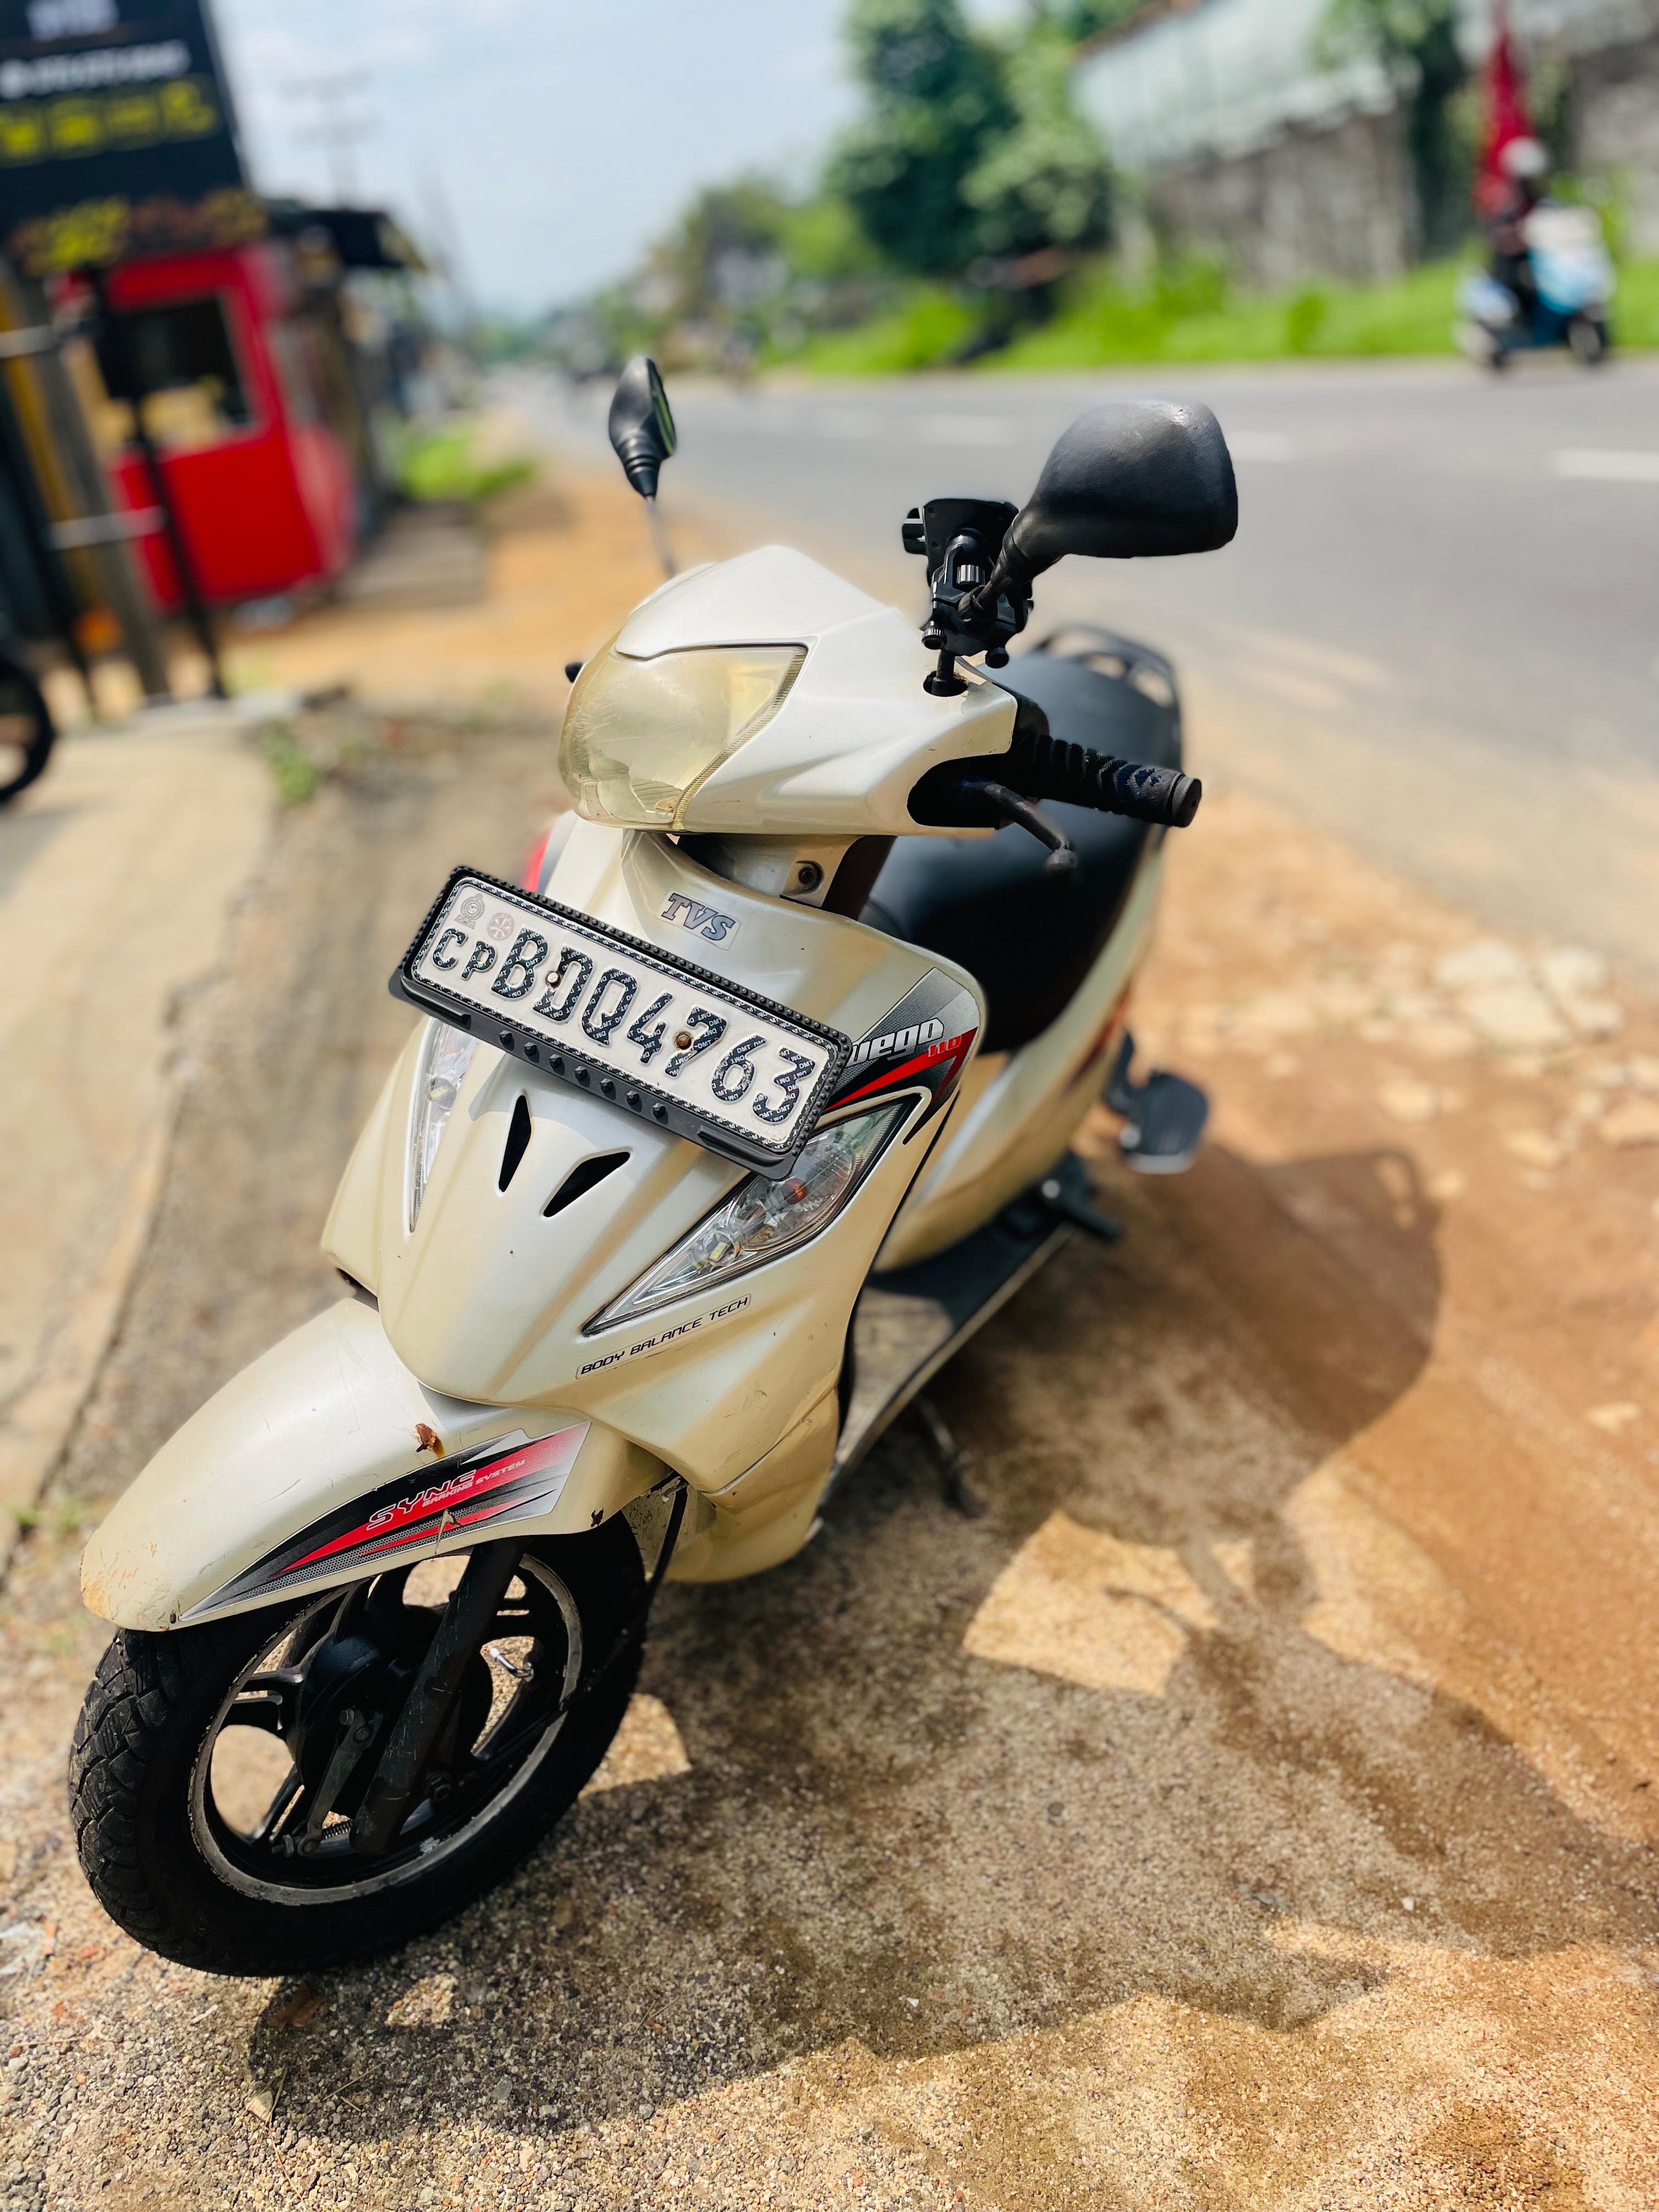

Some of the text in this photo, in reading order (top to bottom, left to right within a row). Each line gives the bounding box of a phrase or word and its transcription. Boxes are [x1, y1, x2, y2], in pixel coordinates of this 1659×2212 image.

[661, 893, 736, 940] TVS
[432, 926, 816, 1123] CP BDQ4763
[845, 1018, 944, 1068] uego
[581, 1297, 748, 1374] BODY BALANCE TECH
[366, 1469, 476, 1531] SYNC
[422, 1459, 526, 1508] BRAKING SYSTEM
